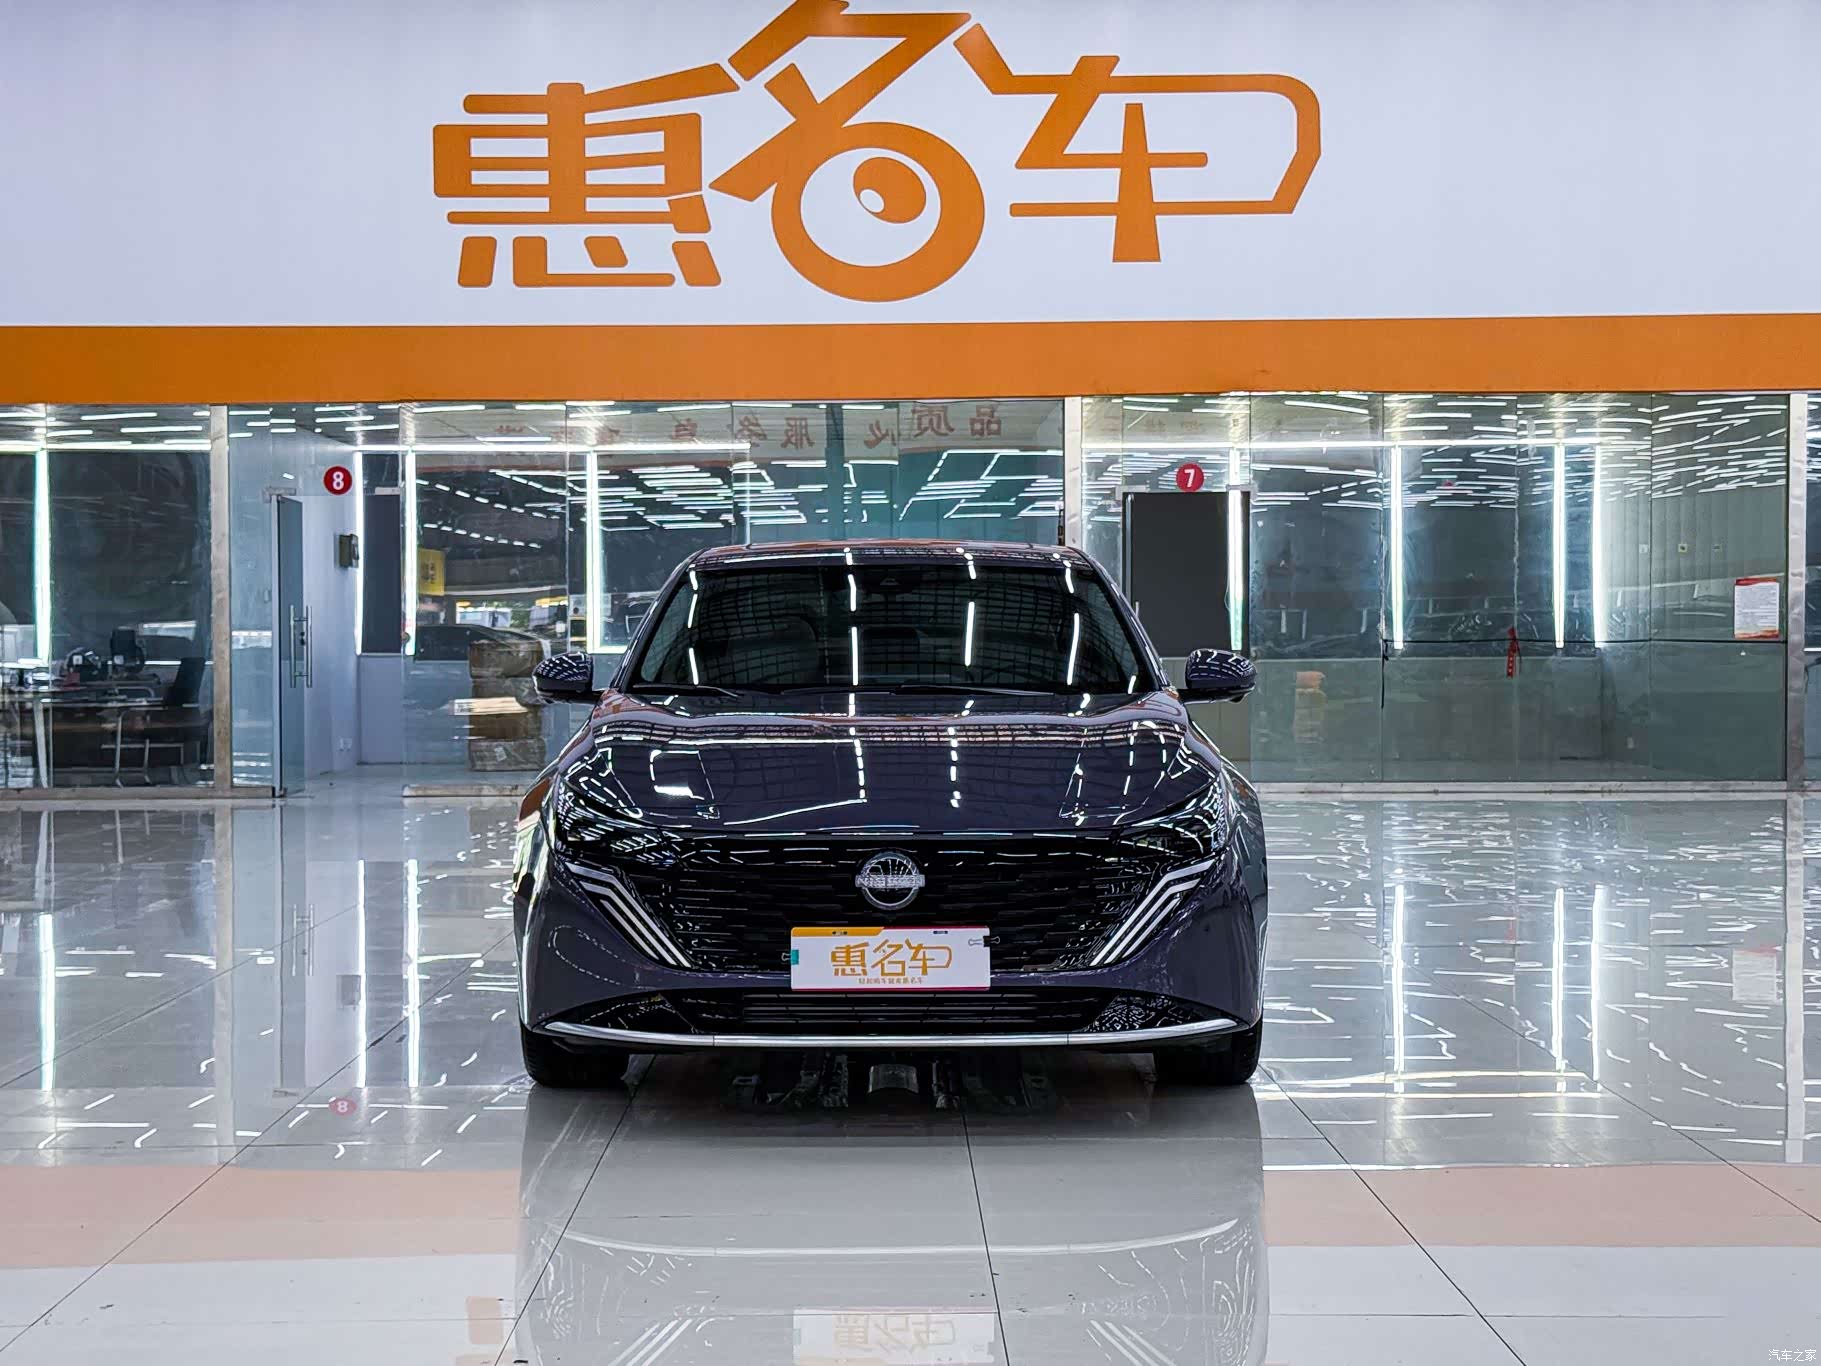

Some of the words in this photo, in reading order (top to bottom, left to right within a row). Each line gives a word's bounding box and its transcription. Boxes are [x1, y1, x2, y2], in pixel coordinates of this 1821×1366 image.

[433, 0, 1322, 302] 惠名车
[332, 471, 345, 490] 8
[1184, 469, 1195, 488] 7
[831, 938, 953, 977] 惠名车
